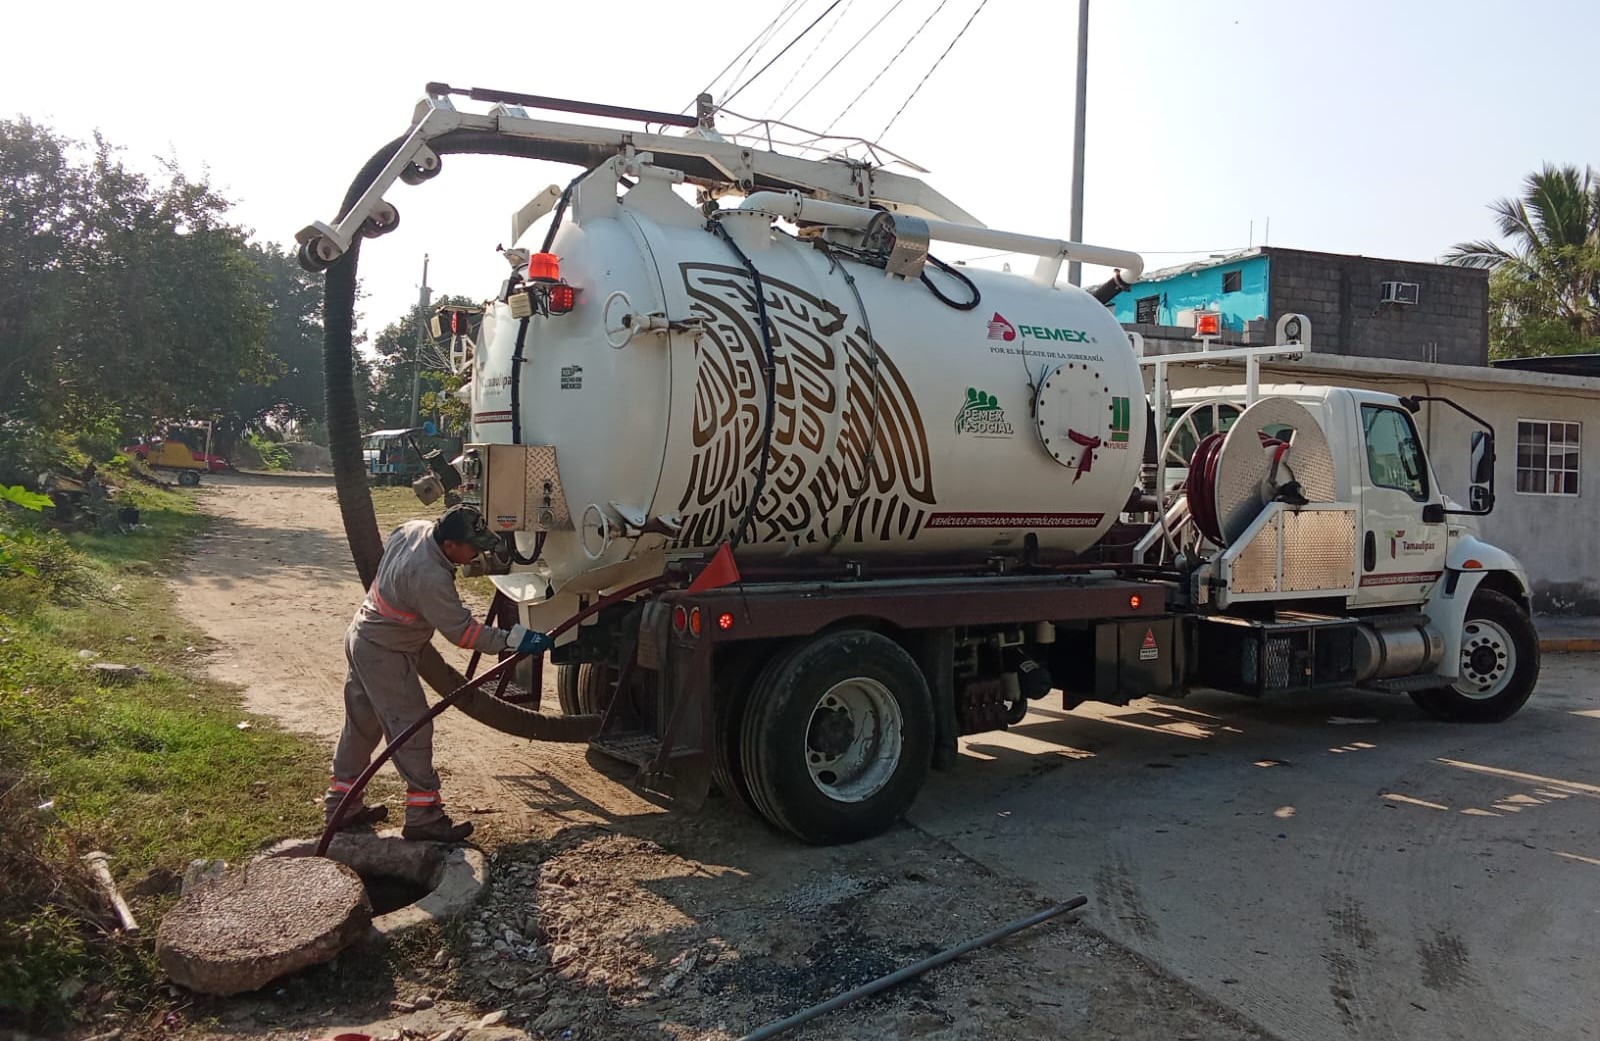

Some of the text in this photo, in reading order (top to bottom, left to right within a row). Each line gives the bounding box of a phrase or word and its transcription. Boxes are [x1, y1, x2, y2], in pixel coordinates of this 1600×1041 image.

[1018, 325, 1090, 343] PEMEX
[1016, 348, 1047, 357] RESCATE
[964, 409, 1005, 423] PEMEX
[931, 516, 1099, 526] VEHÍCULO ENTREGADO POR PETRÓLEOS MEXICANOS
[1403, 541, 1435, 552] Tamaulipas
